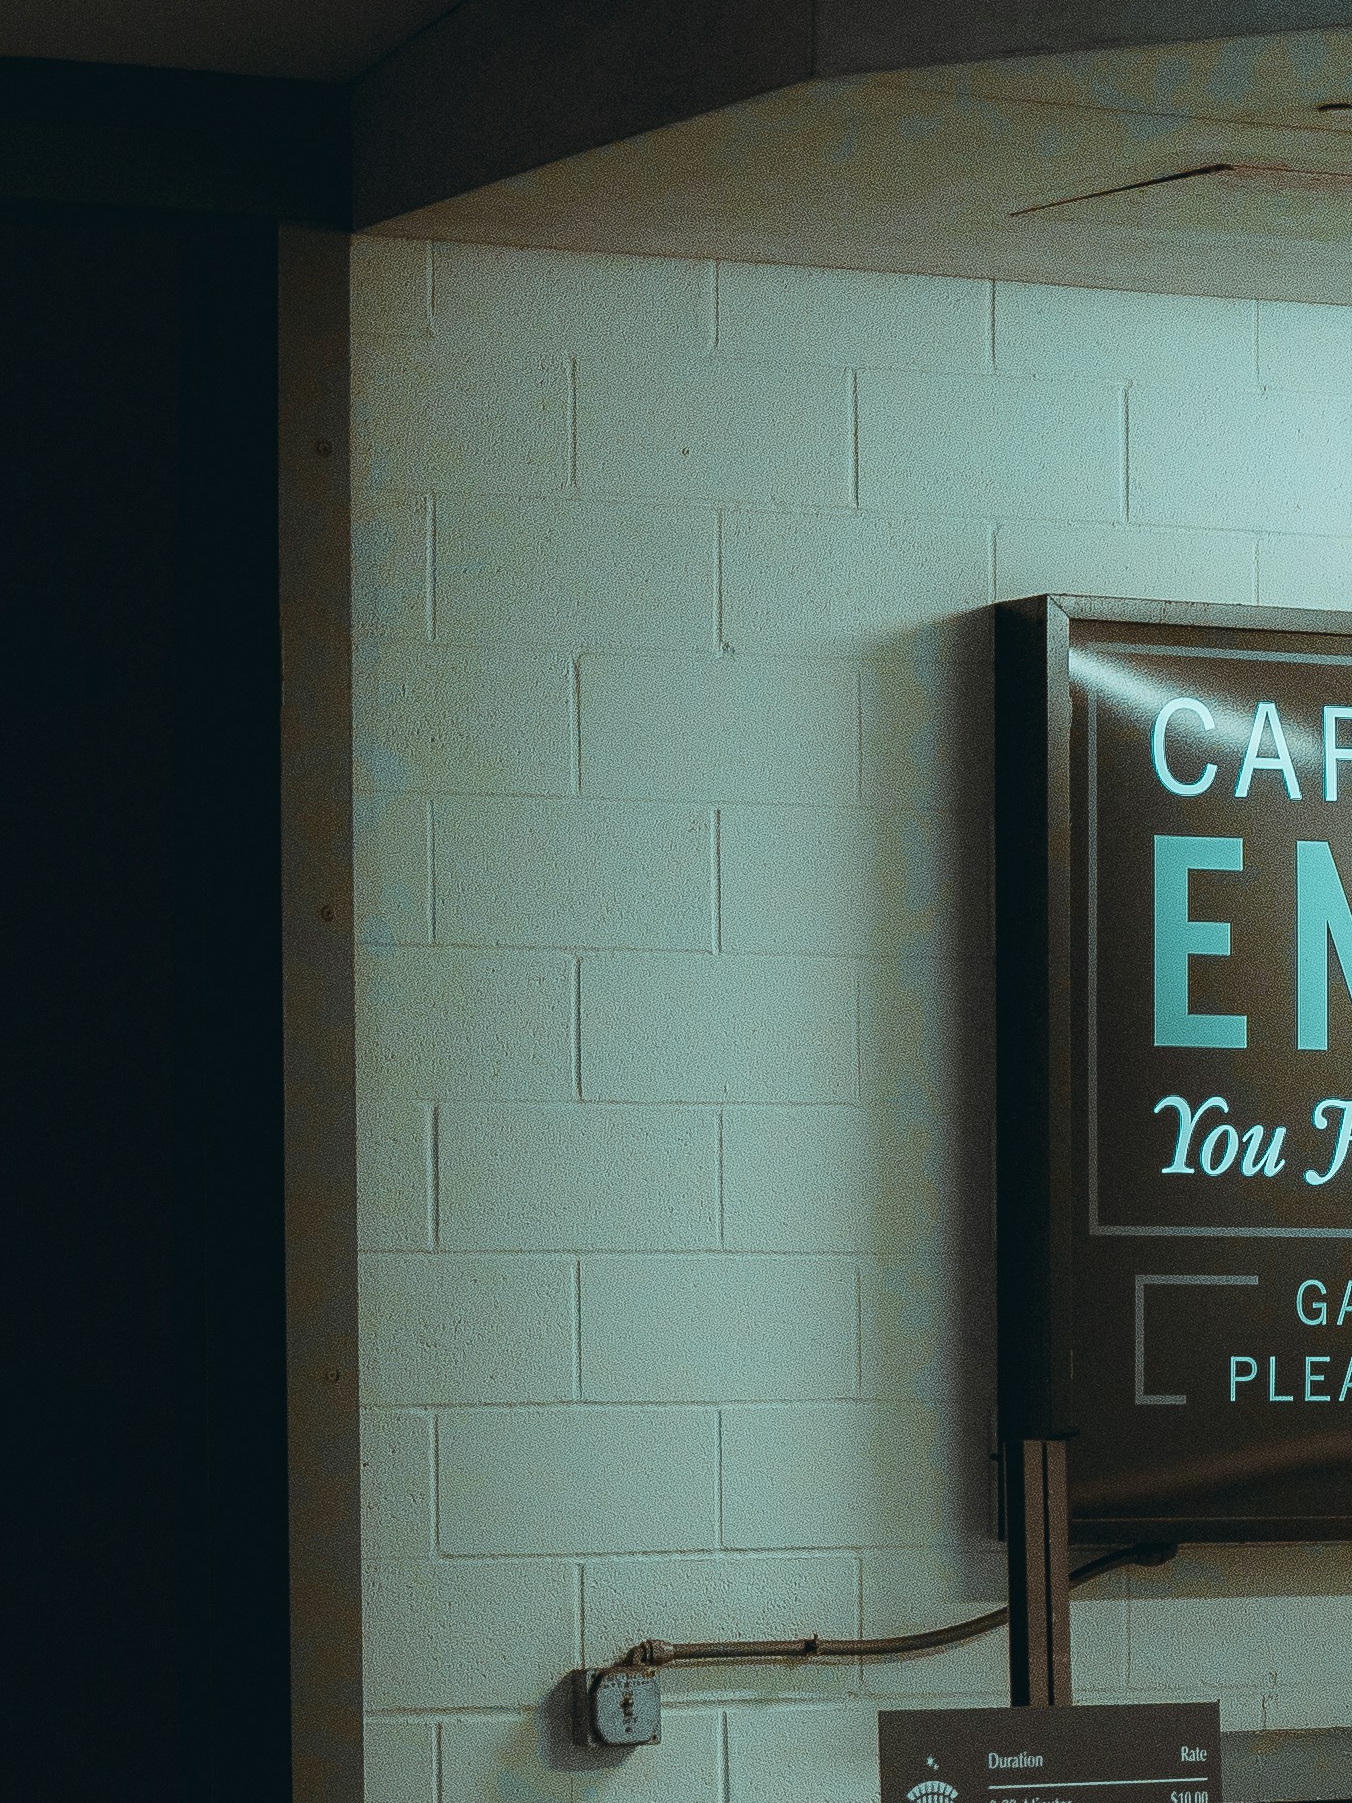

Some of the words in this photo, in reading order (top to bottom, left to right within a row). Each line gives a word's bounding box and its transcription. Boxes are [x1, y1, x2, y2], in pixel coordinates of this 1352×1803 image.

[1152, 1095, 1288, 1181] You
[988, 1751, 1043, 1769] Duration
[1181, 1746, 1208, 1762] Rate
